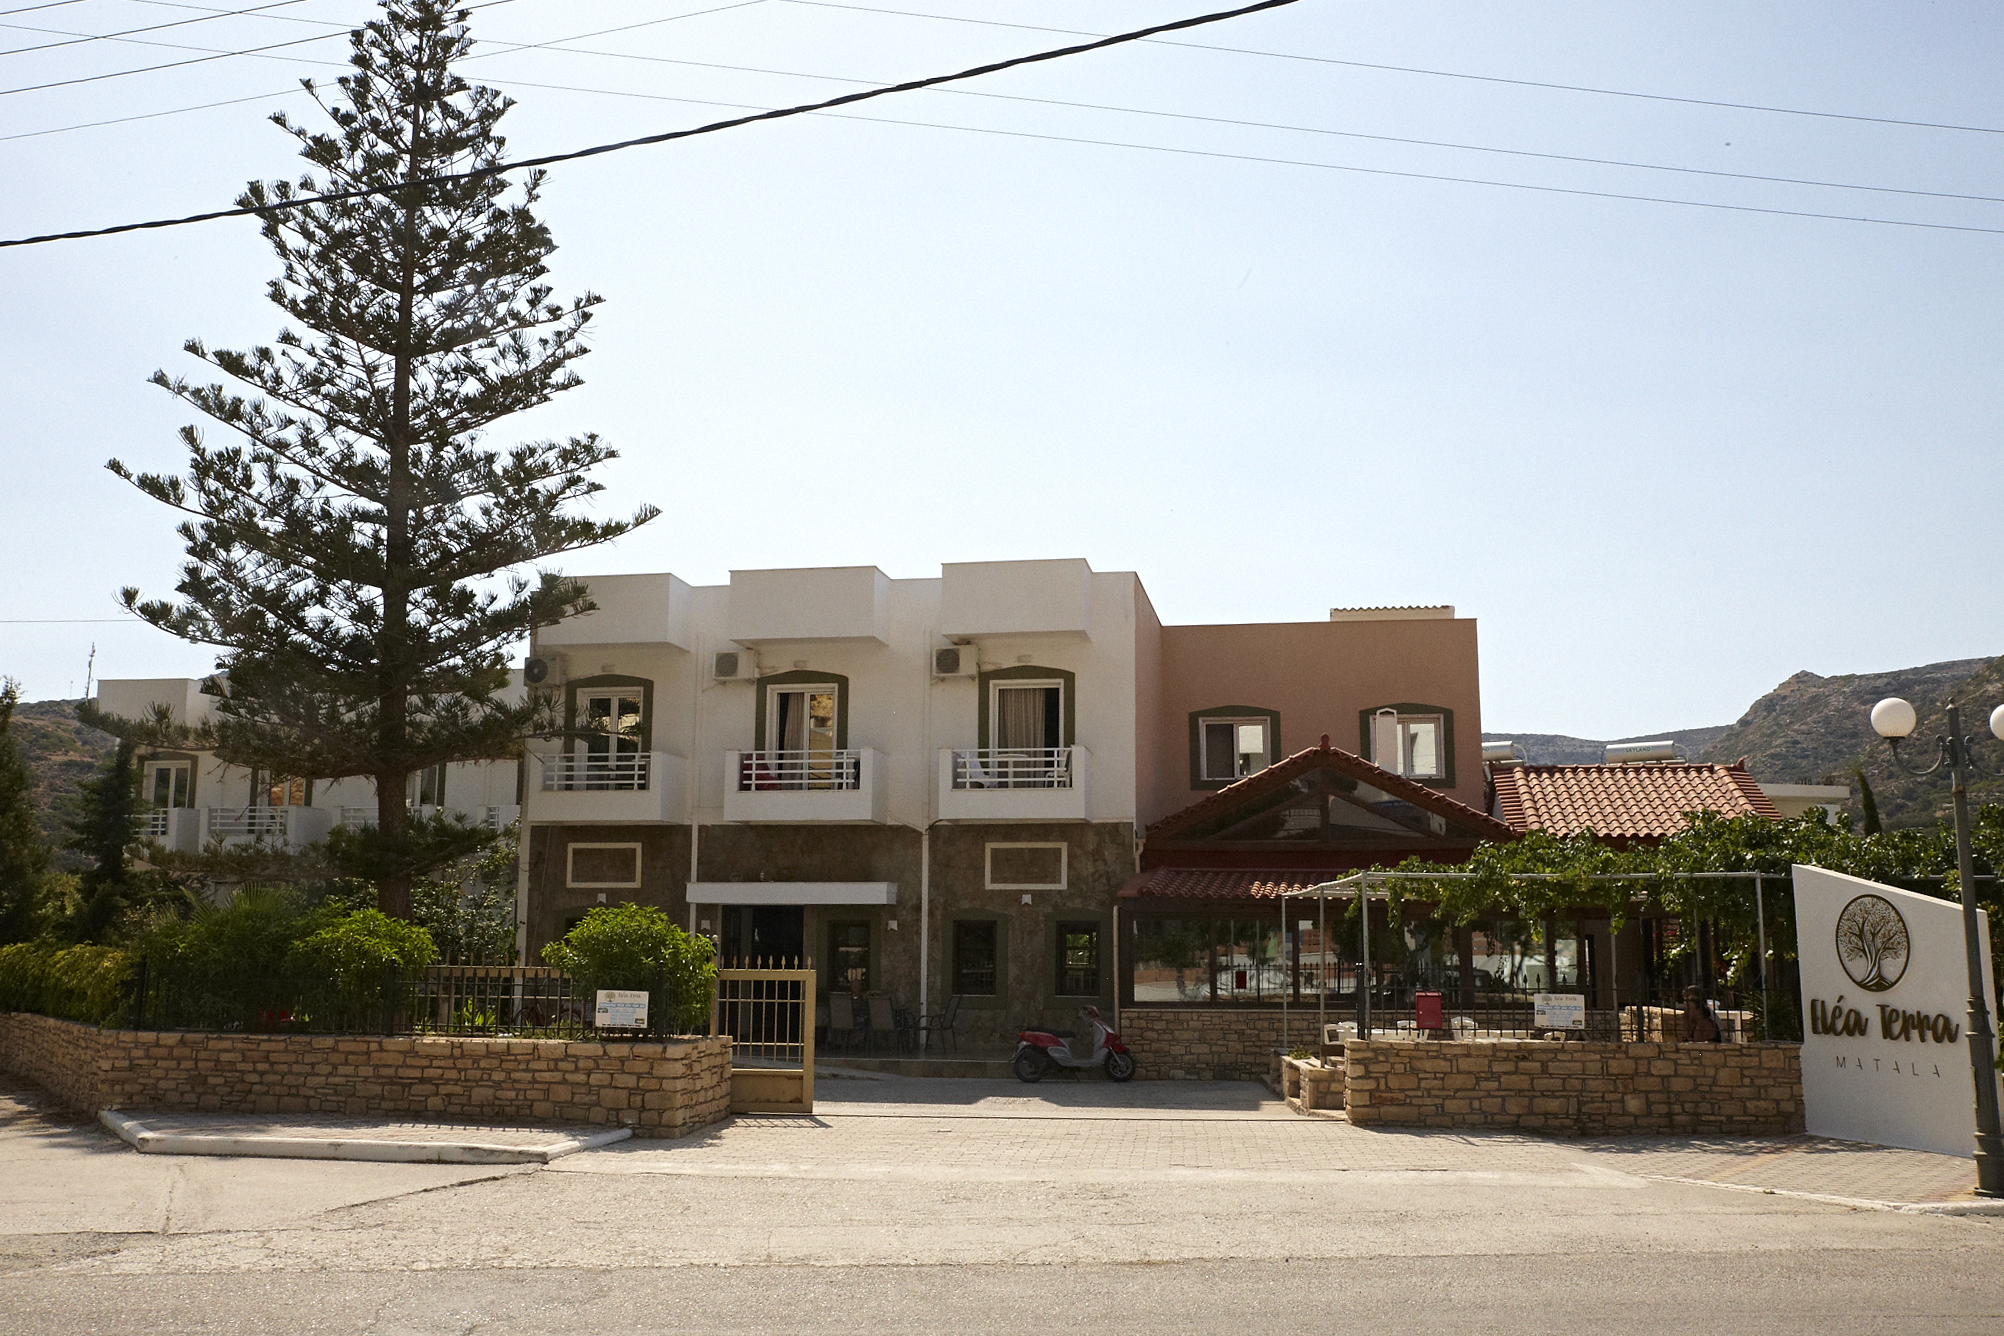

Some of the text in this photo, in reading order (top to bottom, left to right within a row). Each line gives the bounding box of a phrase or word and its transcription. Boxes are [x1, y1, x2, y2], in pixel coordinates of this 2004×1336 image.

[1810, 995, 1960, 1044] Eléa Terra
[1836, 1055, 1941, 1078] MATALA
